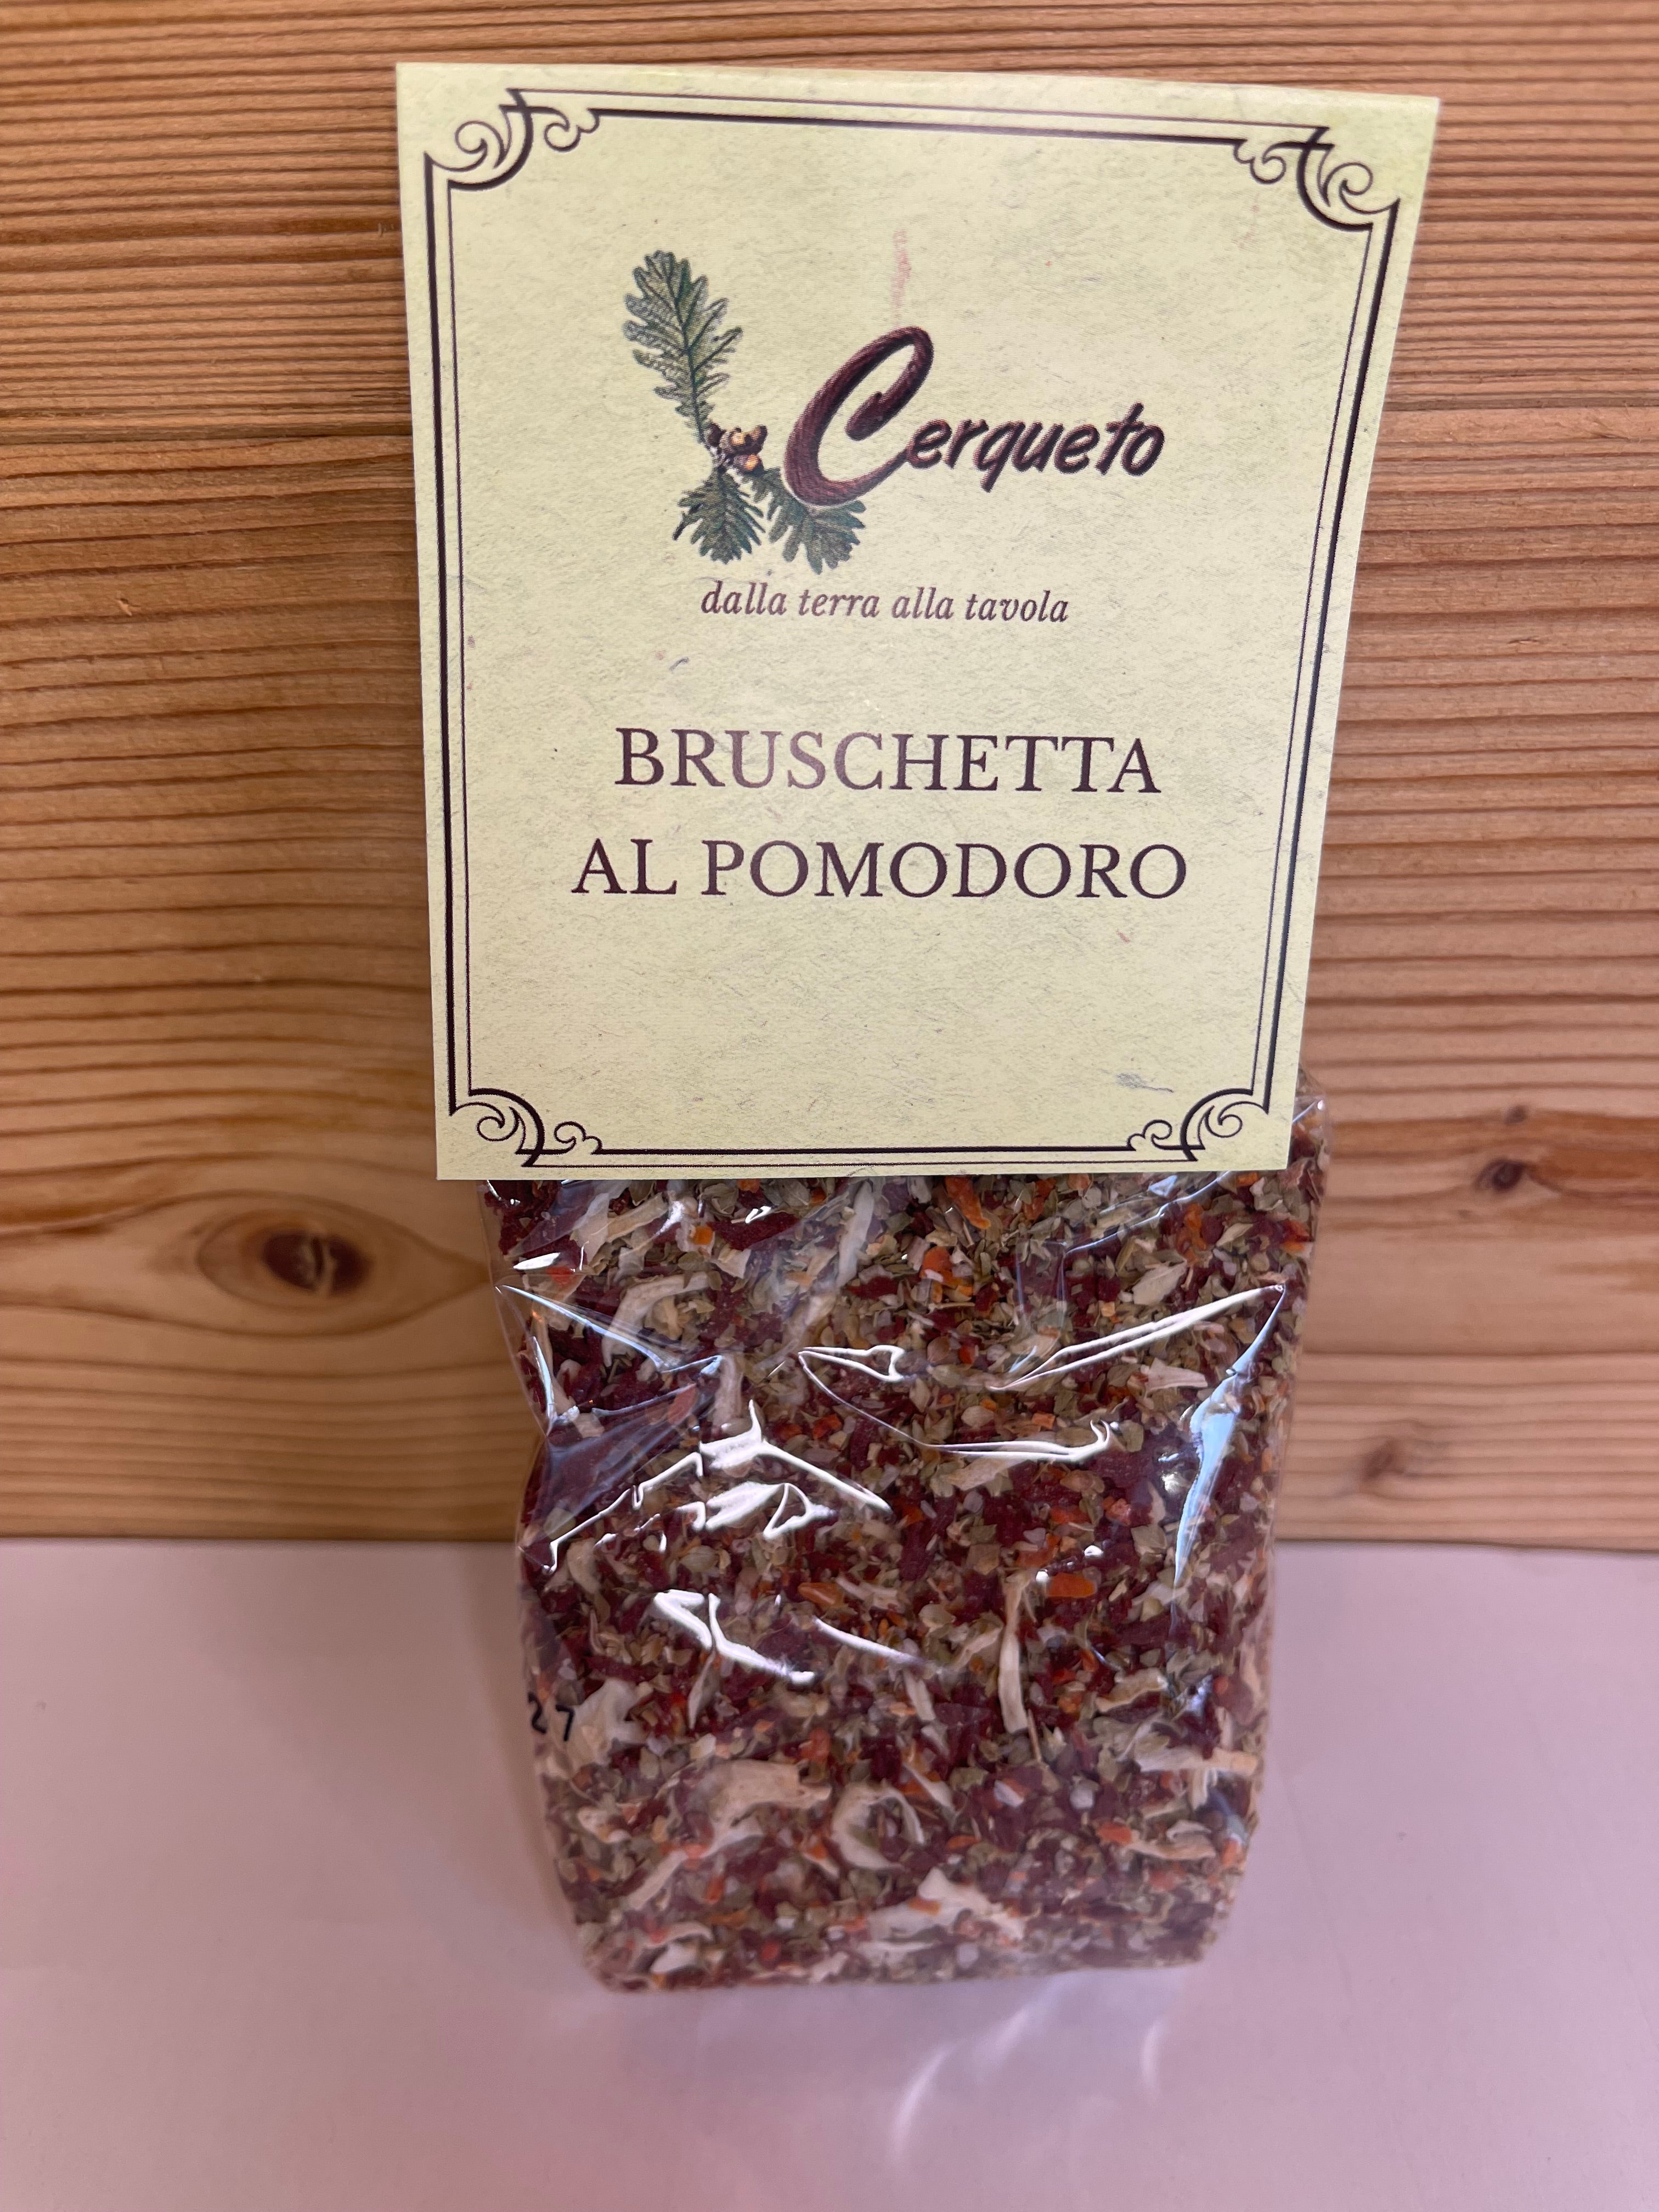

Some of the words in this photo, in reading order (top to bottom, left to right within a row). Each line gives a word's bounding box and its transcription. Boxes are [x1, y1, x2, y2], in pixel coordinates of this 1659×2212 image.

[784, 326, 1165, 506] Cerqueto
[701, 579, 787, 617] dalla
[798, 587, 880, 619] terra
[891, 586, 954, 621] alla
[966, 590, 1069, 624] tavola
[615, 727, 1162, 793] BRUSCHETTA
[571, 838, 678, 896] AL
[701, 839, 1187, 899] POMODORO
